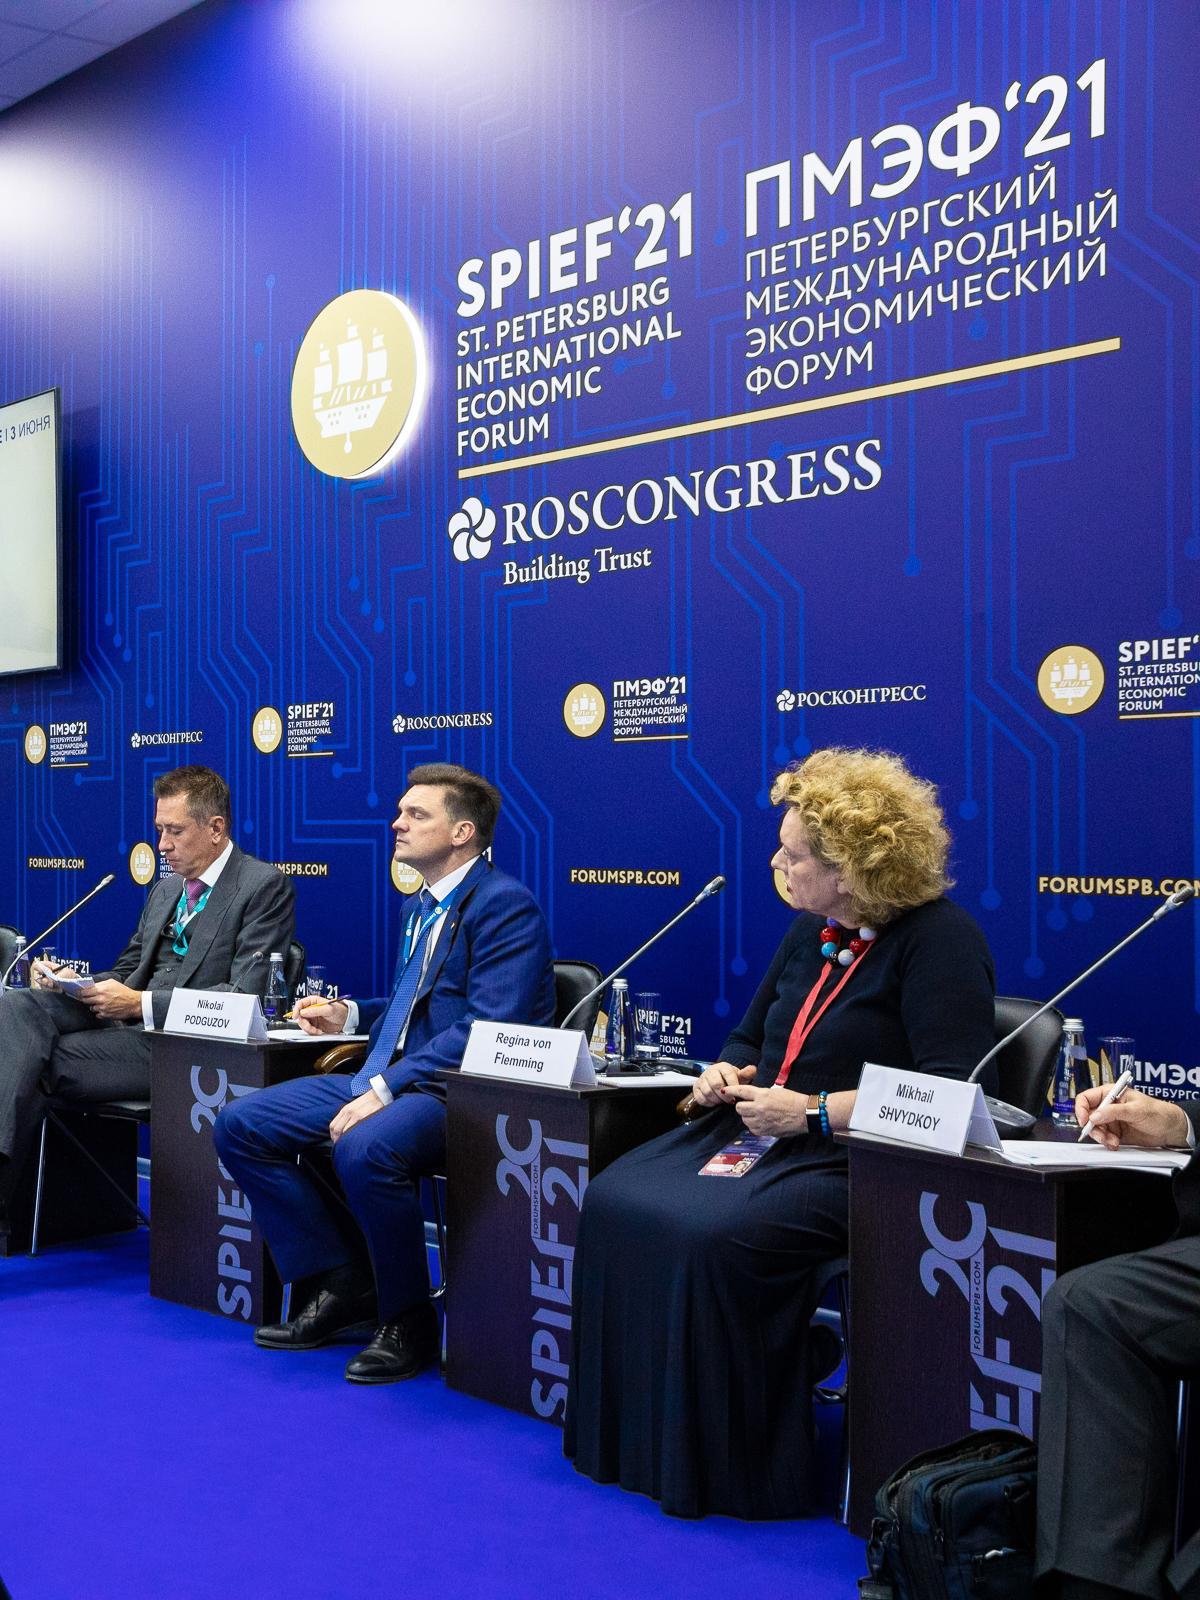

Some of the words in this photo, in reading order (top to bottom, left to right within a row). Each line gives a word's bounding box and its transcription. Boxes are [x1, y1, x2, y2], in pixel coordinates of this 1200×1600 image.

[746, 165, 1057, 281] ПЕТЕРБУРГСКИЙ
[746, 189, 1118, 320] МЕЖДУНАРОДНЫЙ
[746, 239, 1107, 359] ЭКОНОМИЧЕСКИЙ
[457, 327, 491, 358] ST.
[496, 277, 670, 349] PETERSBURG
[457, 312, 682, 391] INTERNATIONAL
[746, 342, 874, 396] ФОРУМ
[457, 366, 602, 423] ECONOMIC
[10, 427, 17, 440] 3
[18, 415, 50, 438] ИЮНЯ
[457, 413, 550, 456] FORUM
[502, 439, 883, 546] ROSCONGRESS
[503, 551, 590, 586] Building
[595, 546, 652, 576] Trust
[1118, 635, 1200, 663] SPIEF‘
[1118, 666, 1135, 677] ST.
[1137, 662, 1200, 675] PETERSBU
[1118, 674, 1200, 688] INTERNATION
[613, 695, 677, 708] ПЕТЕРБУРГСКИЙ
[797, 685, 927, 707] РОСКОНГРЕСС
[1118, 686, 1186, 700] ECONOMIC
[613, 704, 688, 718] МЕЖДУНАРОДНЫЙ
[1118, 700, 1163, 712] FORUM
[296, 719, 329, 728] PETERSBURG
[407, 713, 493, 730] ROSCONGRESS
[613, 714, 686, 727] ЭКОНОМИЧЕСКИЙ
[50, 735, 83, 743] ПЕТЕРБУРГСКИЙ
[141, 731, 203, 745] РОСКОНГРЕСС
[288, 727, 332, 736] INTERNATIONAL
[288, 735, 317, 744] ECONOMIC
[613, 727, 642, 736] ФОРУМ
[288, 744, 308, 752] FORUM
[29, 857, 85, 869] FORUMSPB.COM
[271, 863, 328, 876] MSPB.COM
[570, 868, 680, 886] FORUMSPB.COM
[197, 999, 224, 1012] Nikolai
[184, 1013, 230, 1029] PODGUZOV
[495, 1031, 530, 1049] Regina
[532, 1038, 552, 1049] von
[660, 1035, 685, 1045] SBURG
[494, 1052, 544, 1072] Flemming
[896, 1083, 934, 1104] Mikhail
[878, 1105, 940, 1132] SHVYDKOY
[541, 1137, 589, 1212] 21
[986, 1226, 1056, 1322] 21
[531, 1223, 575, 1423] SPIEF
